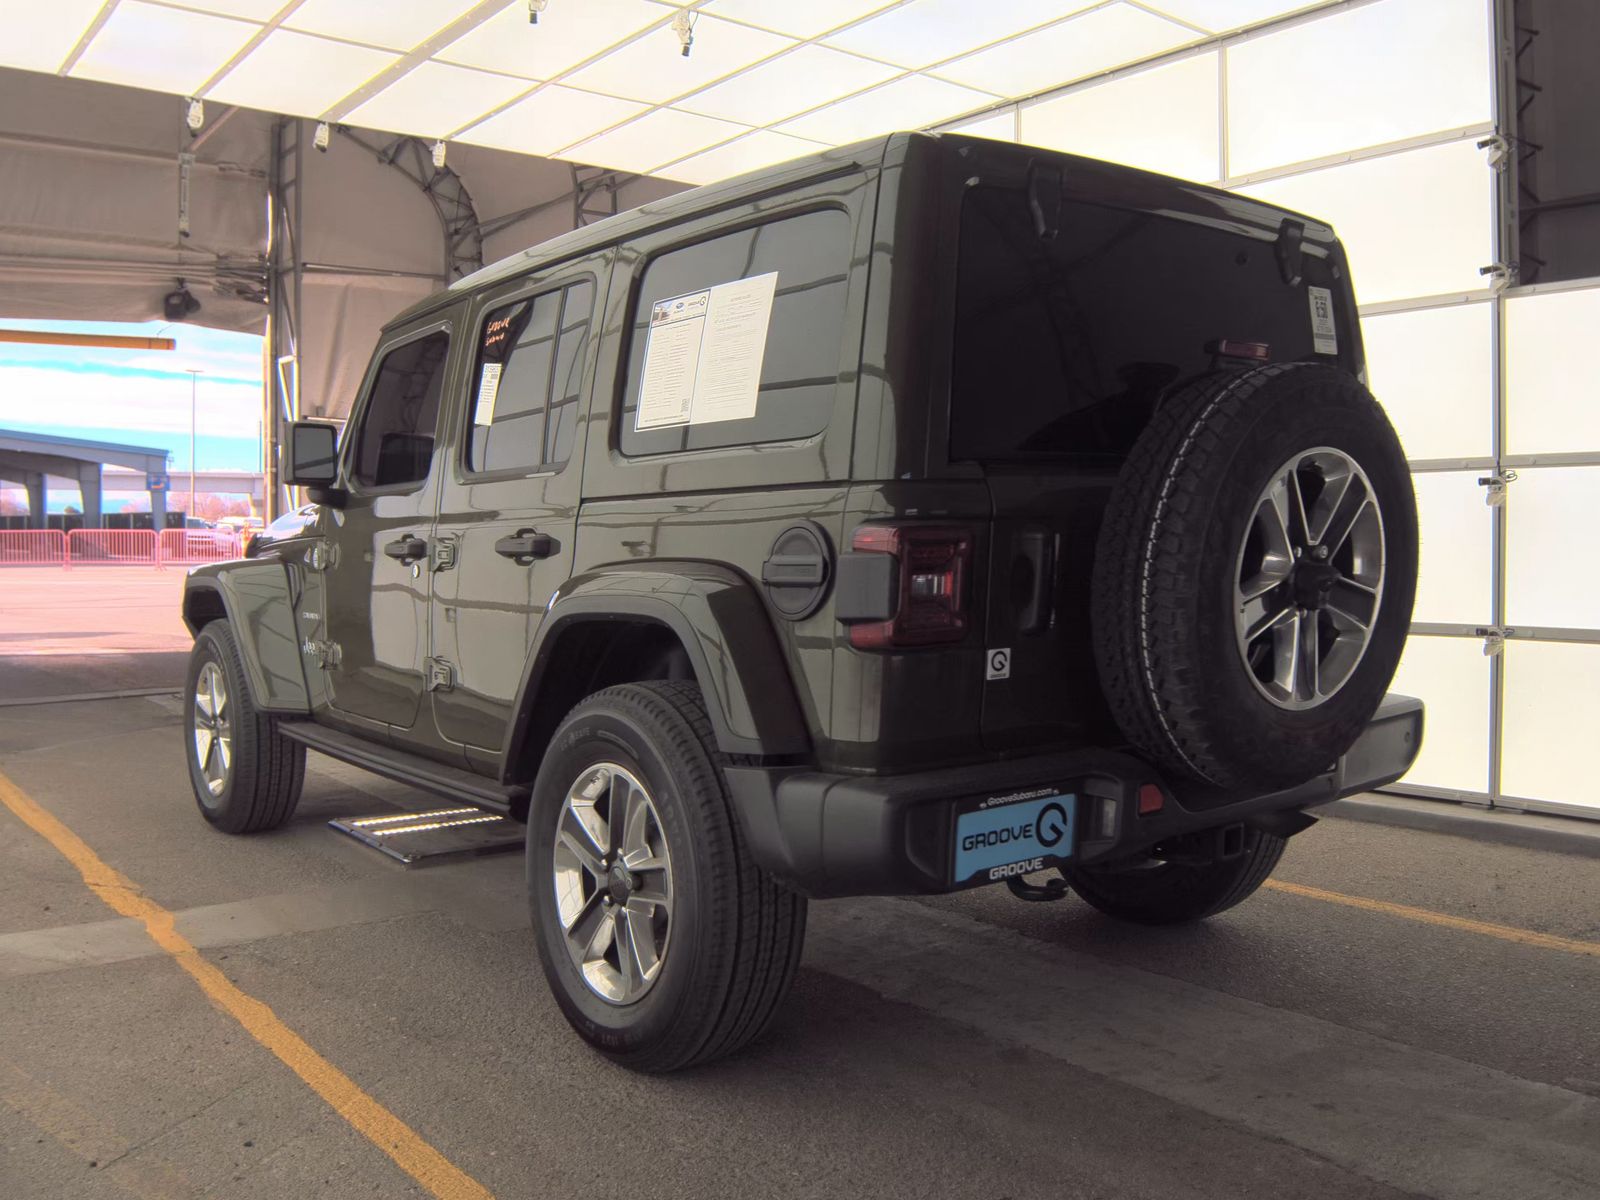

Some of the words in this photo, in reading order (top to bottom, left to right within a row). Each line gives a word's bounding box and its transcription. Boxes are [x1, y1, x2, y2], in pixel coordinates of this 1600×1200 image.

[986, 788, 1053, 806] GrooveSubaru.com
[962, 823, 1034, 852] GROOVE
[989, 857, 1044, 880] GROOVE
